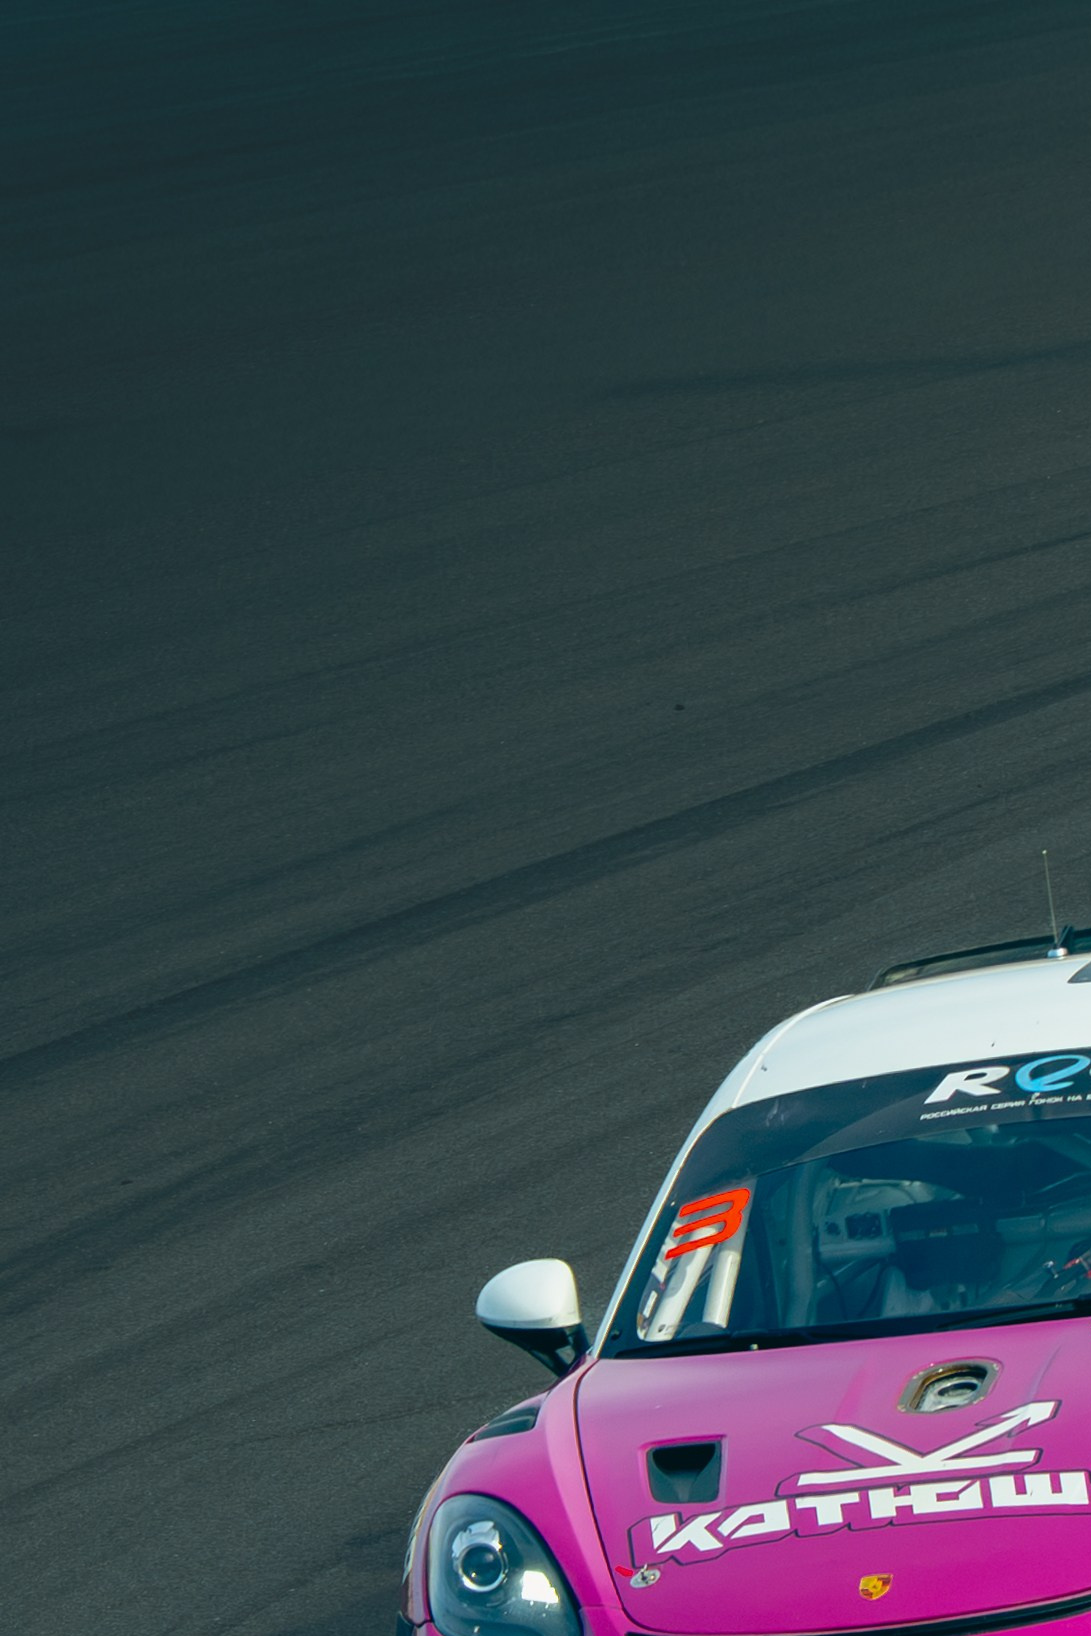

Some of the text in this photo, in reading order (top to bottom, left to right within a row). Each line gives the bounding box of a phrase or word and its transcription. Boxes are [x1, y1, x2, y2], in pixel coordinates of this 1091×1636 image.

[919, 1103, 988, 1121] РОССИЙСКАЯ
[990, 1099, 1026, 1111] СЕРИЯ
[1028, 1095, 1064, 1106] ГОНОК
[1066, 1094, 1083, 1103] НА
[664, 1187, 750, 1261] 3
